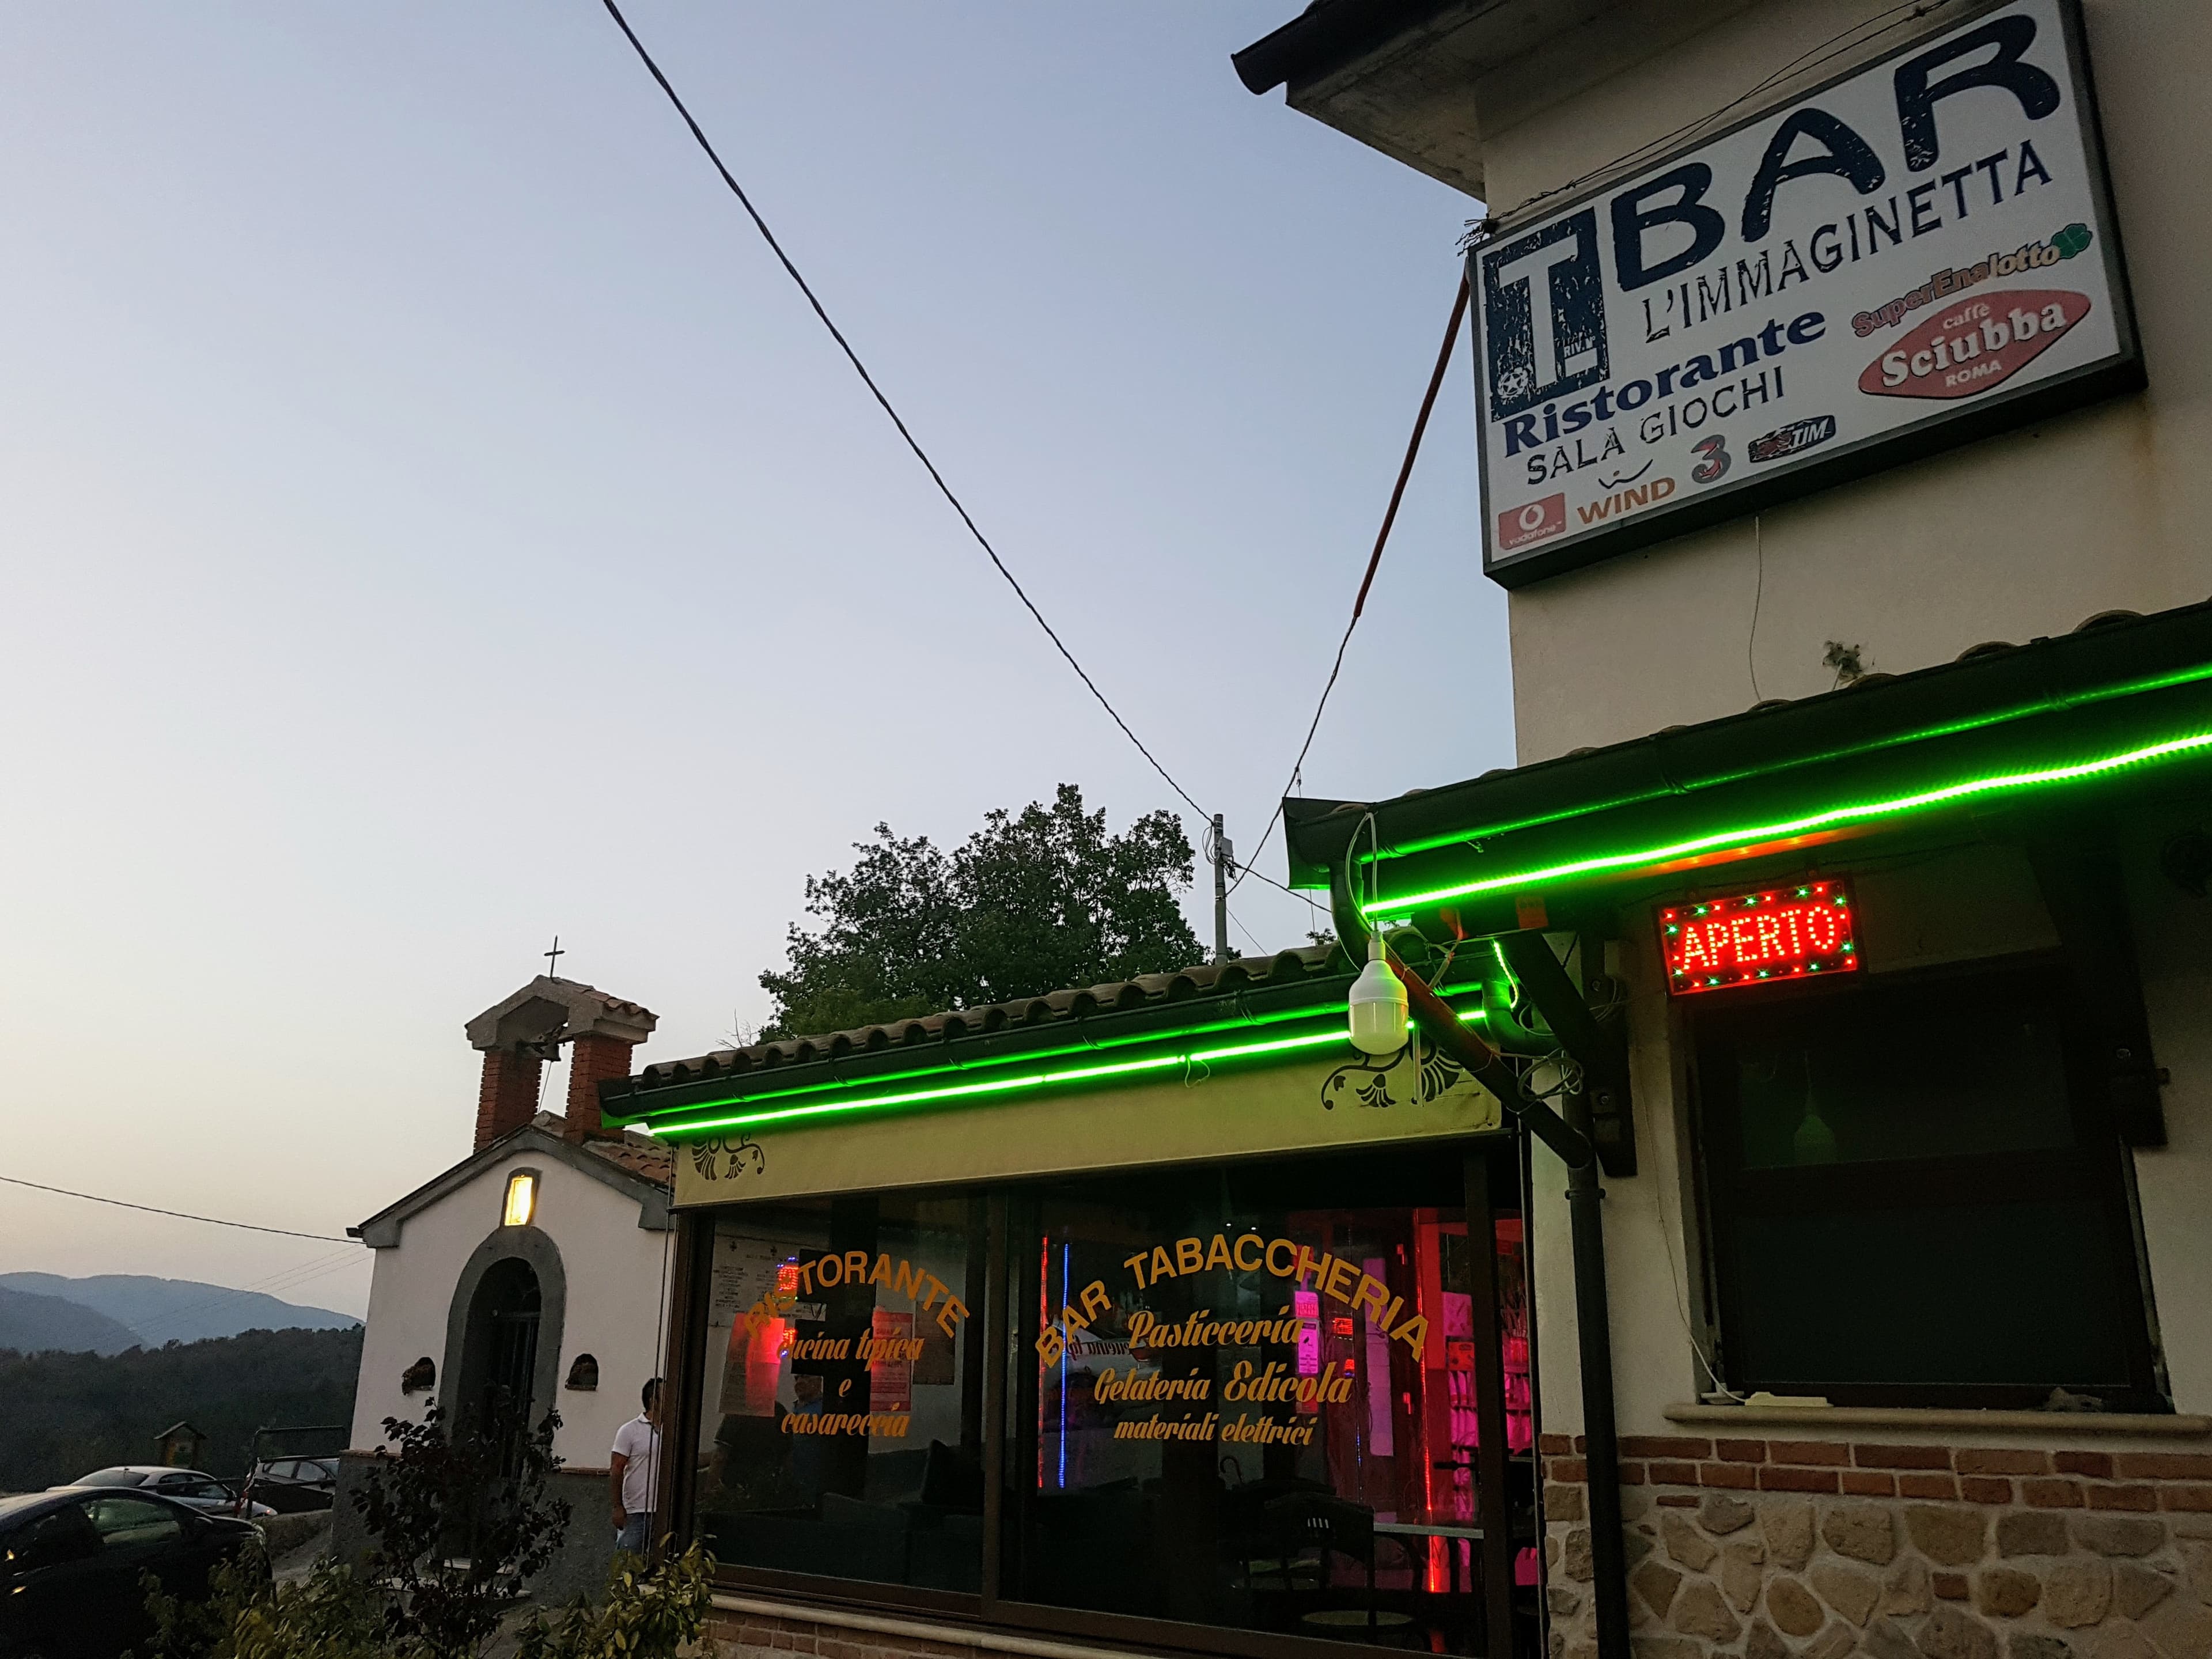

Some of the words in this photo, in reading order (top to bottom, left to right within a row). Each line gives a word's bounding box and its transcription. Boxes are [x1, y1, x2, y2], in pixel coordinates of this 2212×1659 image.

[1611, 14, 2060, 291] BAR
[1643, 139, 2052, 343] L'IMMAGINETTA
[1851, 241, 2062, 338] SuperEnalotto
[1881, 302, 2067, 388] Sciubba
[1502, 312, 1826, 458] Ristorante
[1946, 359, 2002, 387] ROMA
[1527, 426, 1626, 484] SALA
[1639, 365, 1785, 444] GIOCHI
[1789, 418, 1830, 450] TIM
[1691, 434, 1732, 484] 3
[1577, 477, 1676, 525] WIND
[1509, 524, 1556, 546] vodafone
[1682, 906, 1835, 970] APERTO
[1035, 1280, 1113, 1368] BAR
[1124, 1234, 1429, 1363] TABACCHERIA
[855, 1327, 926, 1372] tipica
[1127, 1305, 1305, 1350] Pasticceria
[839, 1378, 852, 1398] e
[1094, 1368, 1211, 1405] Gelateria
[1224, 1360, 1355, 1404] Edicola
[781, 1402, 910, 1437] casareccia
[1113, 1412, 1220, 1441] materiali
[1221, 1412, 1319, 1446] elettrici
